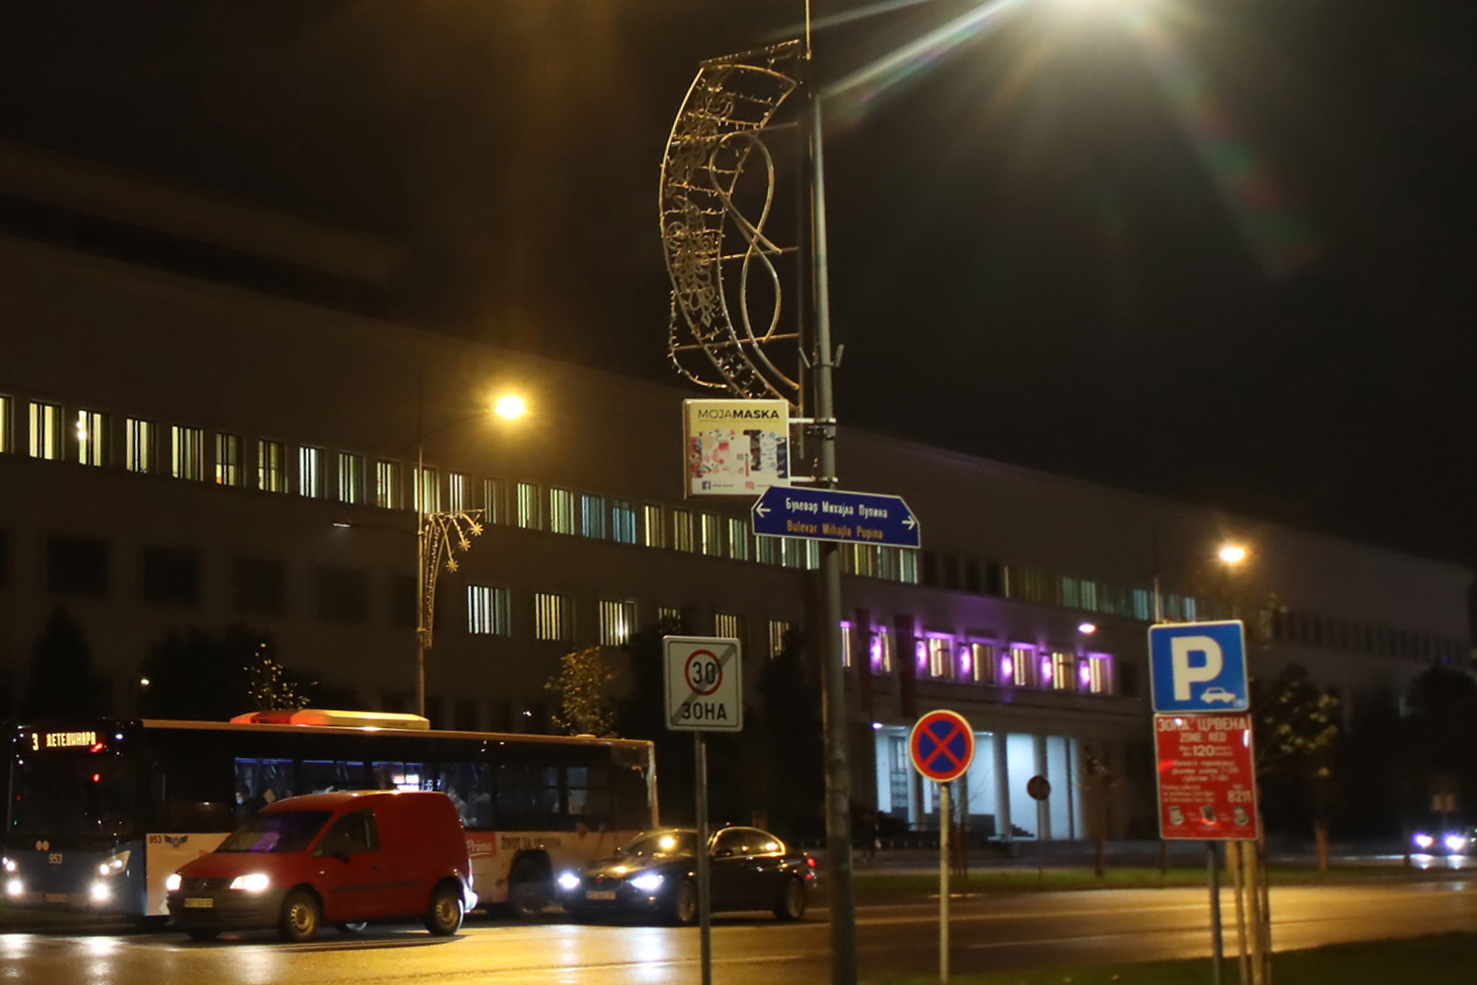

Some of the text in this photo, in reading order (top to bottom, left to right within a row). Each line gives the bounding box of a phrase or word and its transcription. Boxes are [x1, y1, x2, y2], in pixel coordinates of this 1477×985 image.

[698, 409, 780, 420] MOJAMASKA
[785, 497, 888, 520] Булевар Михајла Пупина
[786, 519, 884, 540] Bulevar Mihajla Pupina
[692, 661, 716, 685] 30
[1170, 635, 1224, 702] P
[681, 702, 728, 720] ЗОНА
[1197, 717, 1247, 732] ЦРВЕНА
[31, 733, 40, 751] 3
[1192, 745, 1214, 757] 120
[148, 834, 162, 845] 953
[48, 853, 63, 865] 953
